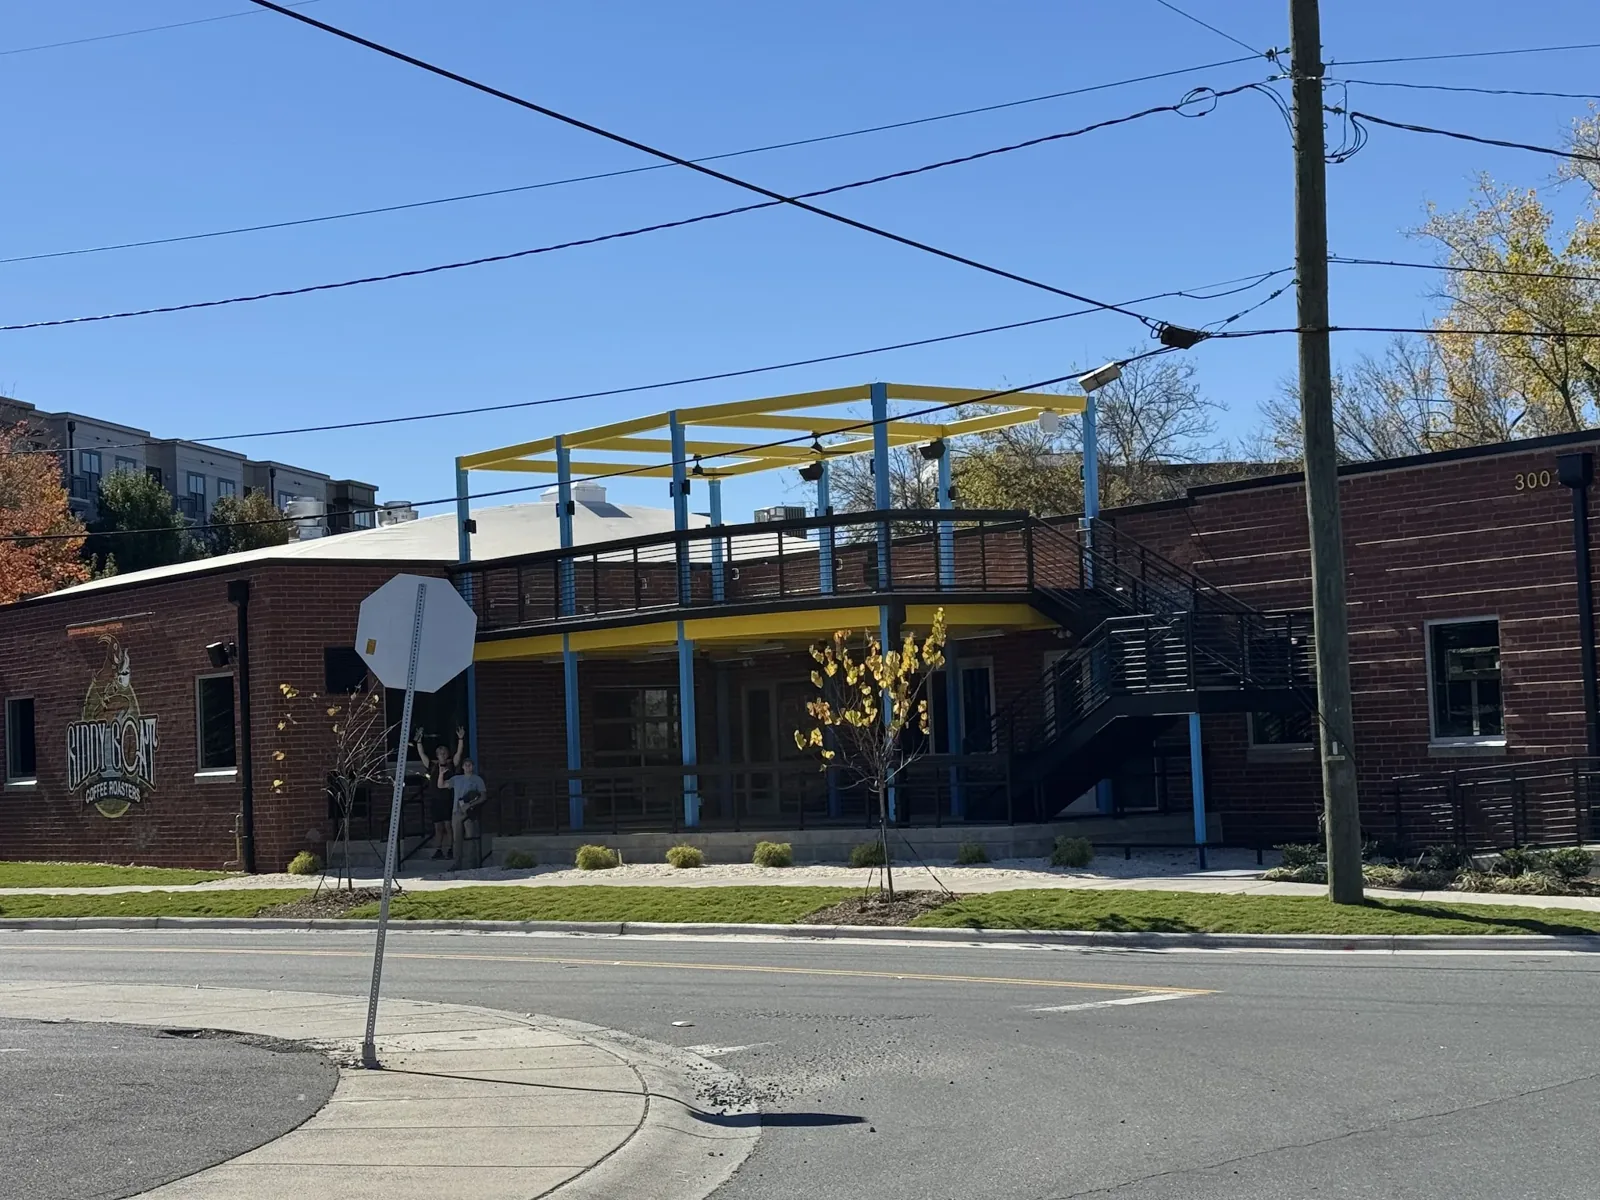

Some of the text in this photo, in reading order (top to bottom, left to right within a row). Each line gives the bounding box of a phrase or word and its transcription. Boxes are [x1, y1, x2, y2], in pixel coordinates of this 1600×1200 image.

[1514, 470, 1550, 491] 300
[67, 718, 158, 791] GIDDY GOAT
[85, 781, 141, 804] COFFEE ROASTERS
